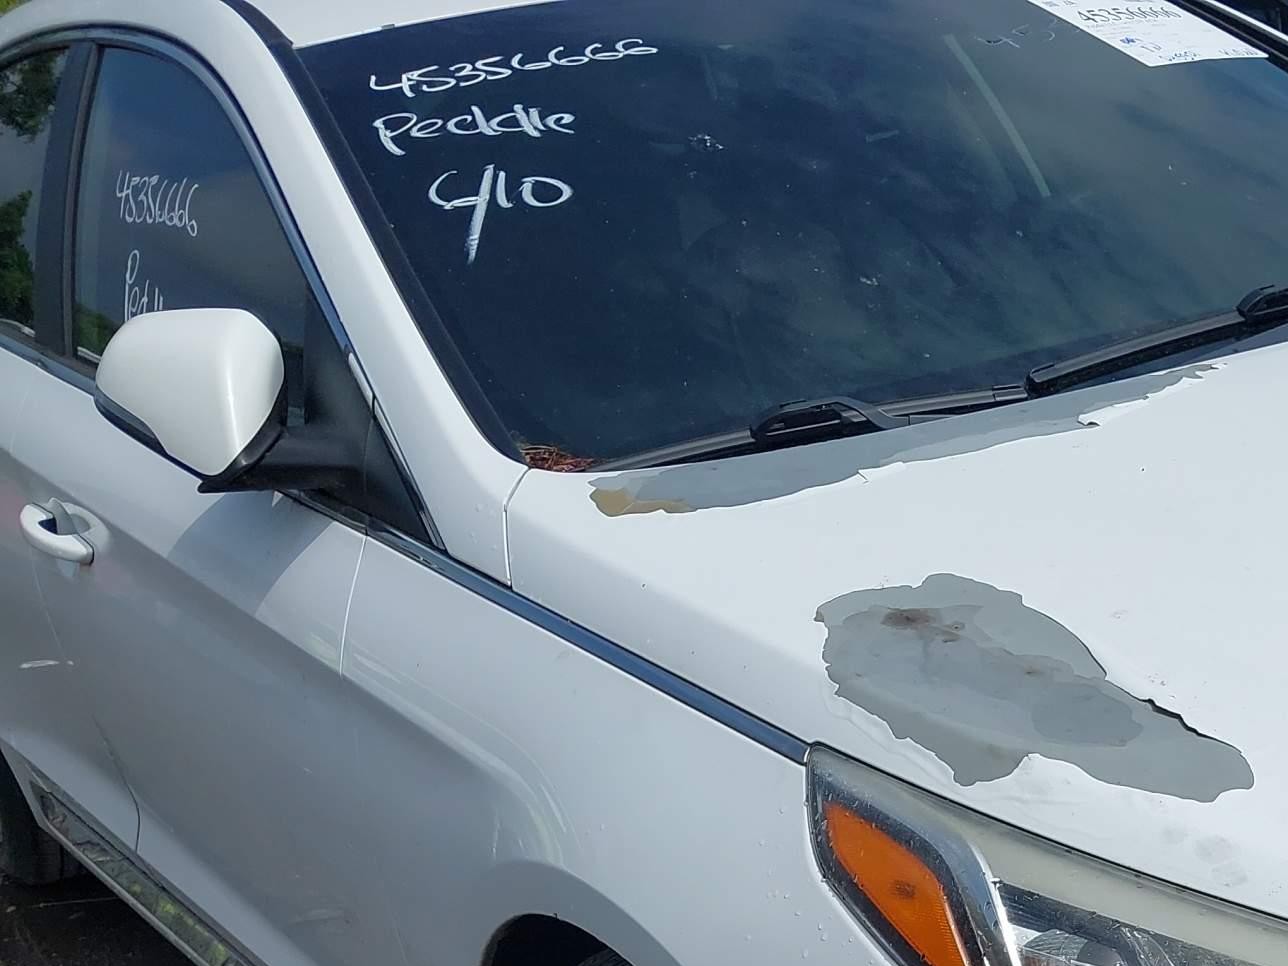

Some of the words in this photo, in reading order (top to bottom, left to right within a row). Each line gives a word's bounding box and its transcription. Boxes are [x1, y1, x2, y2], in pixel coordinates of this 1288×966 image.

[1077, 6, 1183, 24] 45356666
[369, 38, 659, 98] 45356666
[373, 104, 576, 156] Peddle
[116, 170, 199, 237] 45356666
